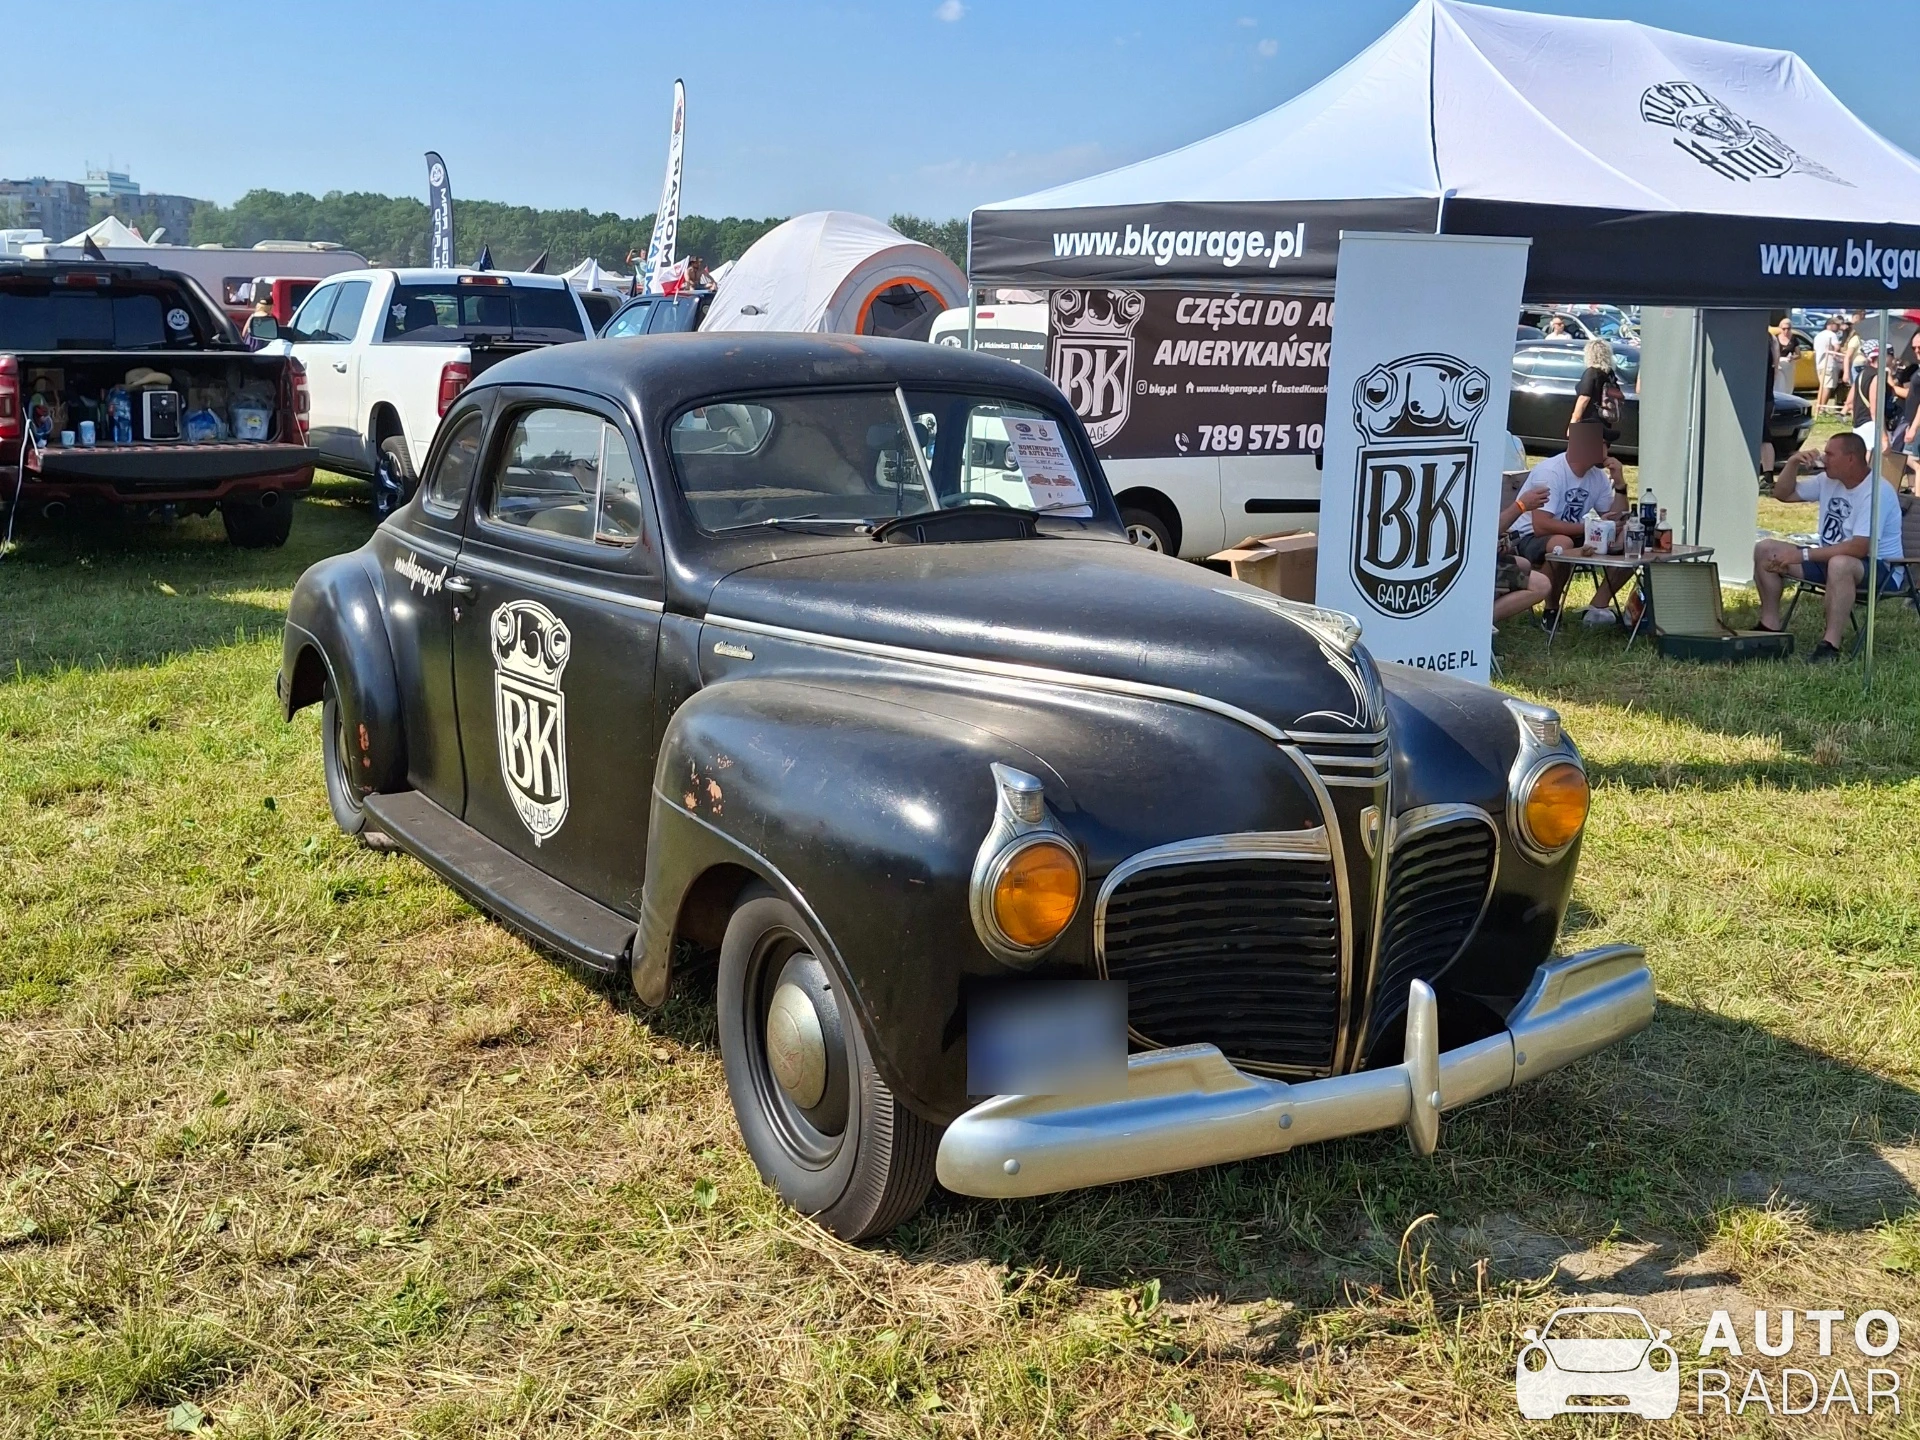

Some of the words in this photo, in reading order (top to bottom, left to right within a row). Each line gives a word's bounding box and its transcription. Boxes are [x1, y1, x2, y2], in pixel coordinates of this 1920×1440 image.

[1053, 223, 1304, 268] www.bkgarage.pl
[1760, 239, 1920, 290] www.bkga
[1176, 293, 1262, 331] CZĘŚCI
[1264, 300, 1302, 326] DO
[1153, 333, 1331, 367] AMERYKAŃSK
[1060, 348, 1127, 416] BK
[1149, 384, 1177, 397] bkg.pl
[1196, 384, 1267, 396] www.bkgarage.pl
[1089, 423, 1109, 441] AGE
[1198, 424, 1244, 451] 789
[1248, 424, 1291, 450] 575
[1296, 424, 1325, 449] 10
[1364, 461, 1466, 570] BK
[1377, 577, 1439, 611] GARAGE
[502, 689, 560, 798] BK
[519, 796, 552, 829] GARAGE
